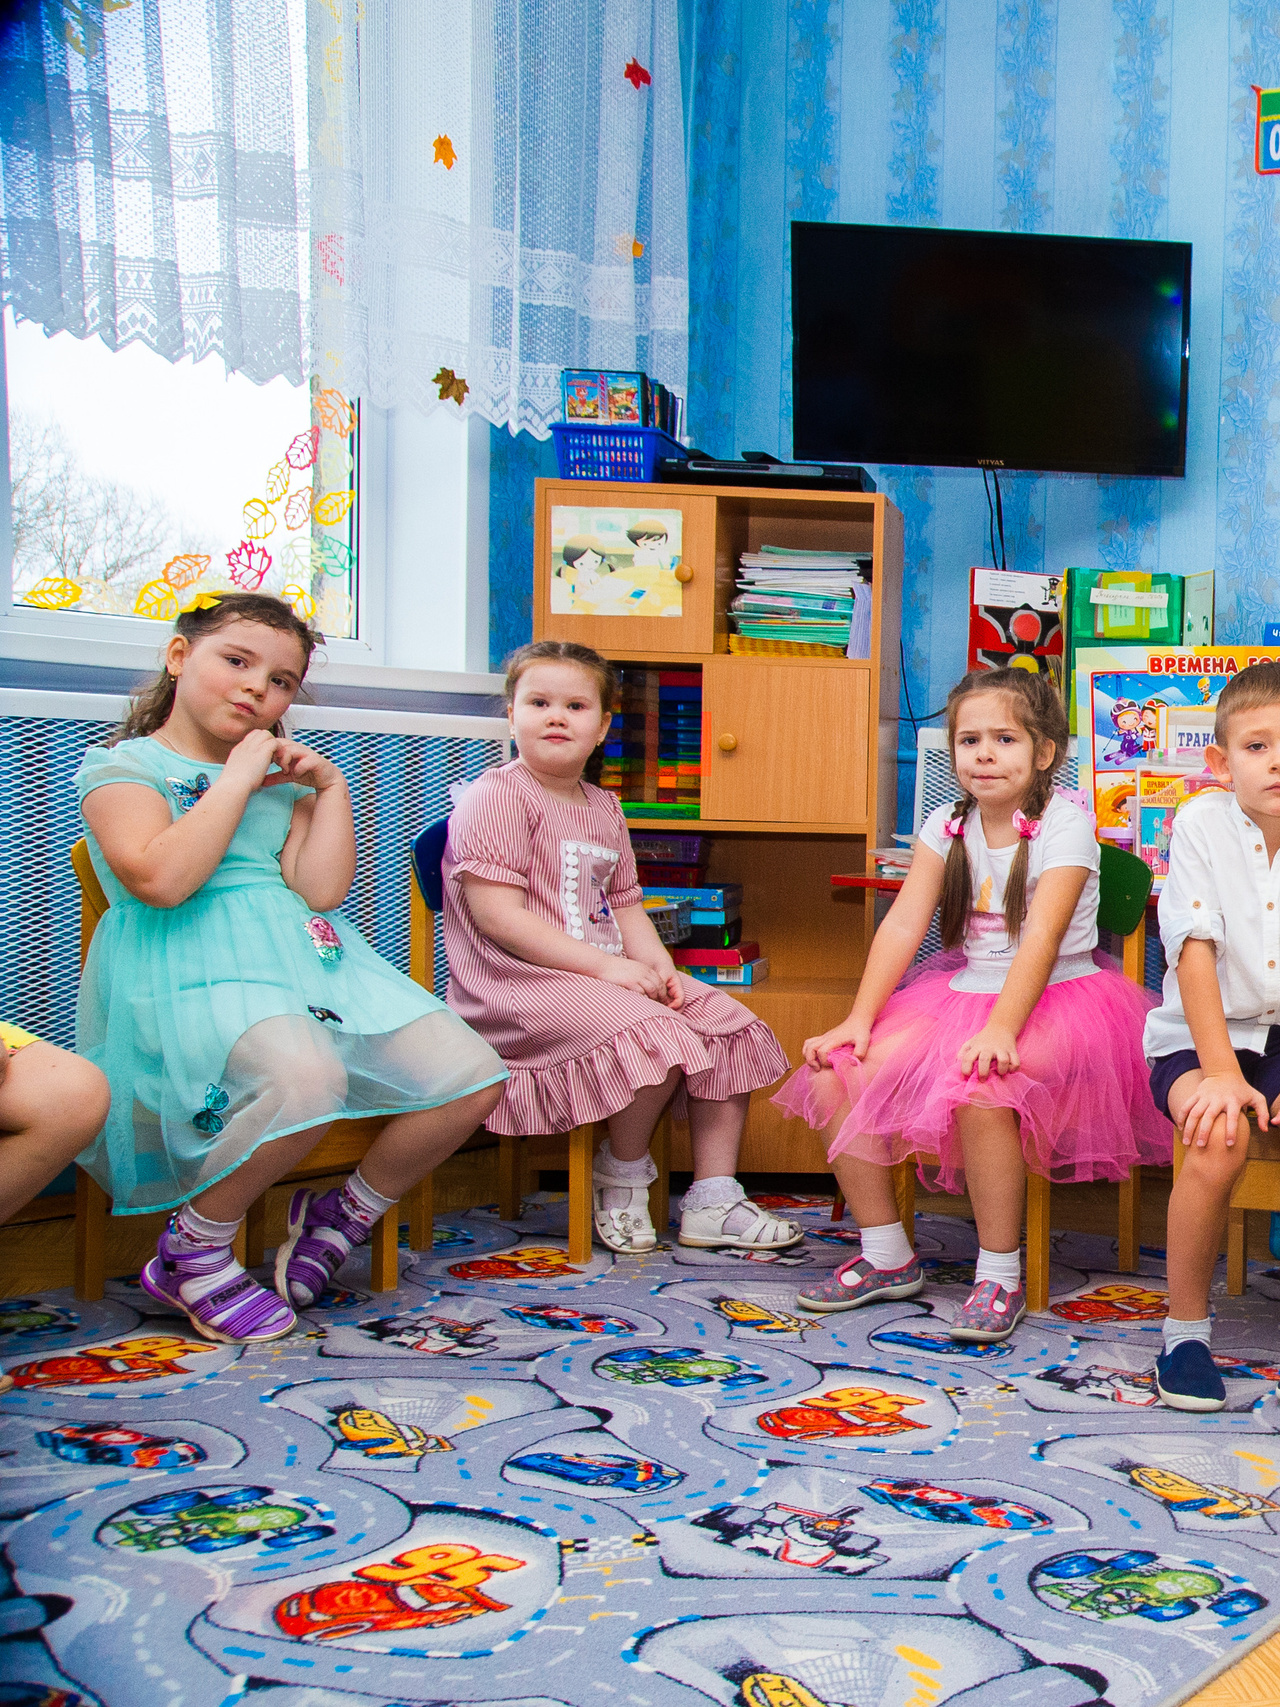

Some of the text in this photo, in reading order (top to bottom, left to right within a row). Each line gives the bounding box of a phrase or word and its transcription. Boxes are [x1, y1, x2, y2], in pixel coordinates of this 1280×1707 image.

[1149, 656, 1238, 674] ВРЕМЕНА
[1076, 1284, 1169, 1304] 95
[78, 1336, 218, 1361] 95
[798, 1386, 926, 1414] 95
[352, 1543, 527, 1589] 95
